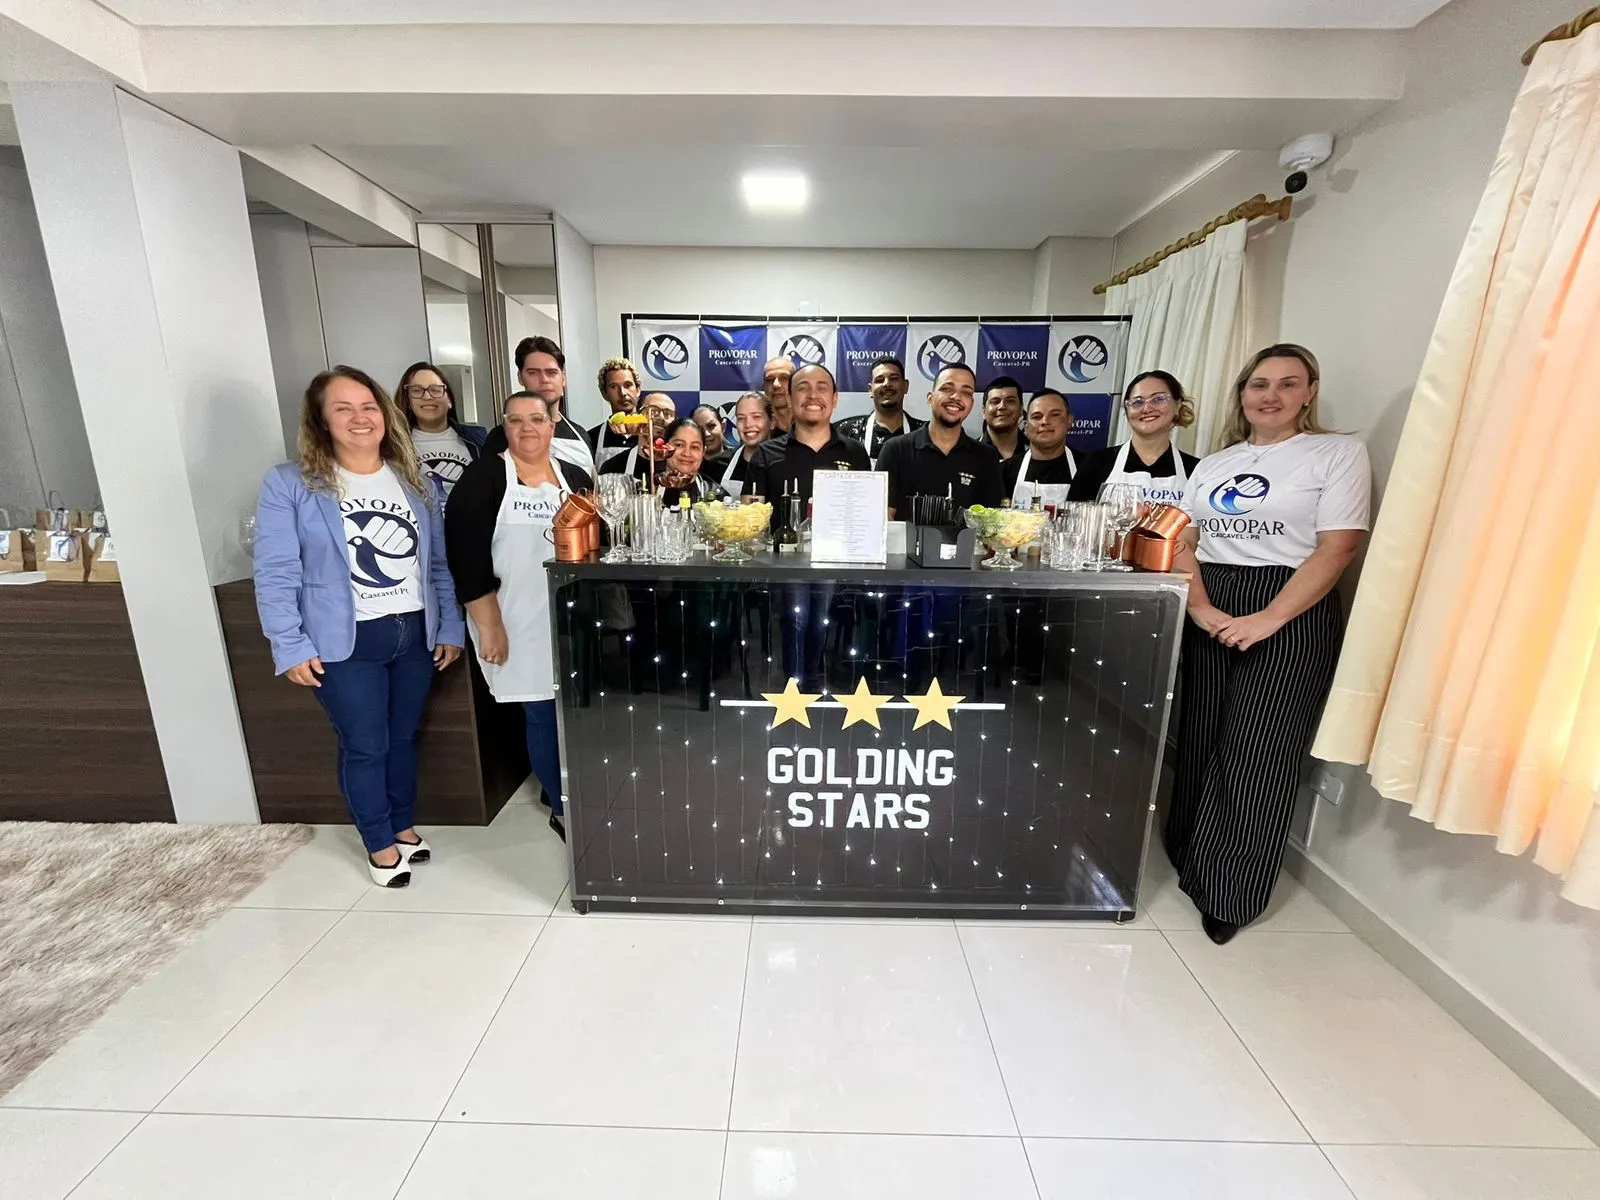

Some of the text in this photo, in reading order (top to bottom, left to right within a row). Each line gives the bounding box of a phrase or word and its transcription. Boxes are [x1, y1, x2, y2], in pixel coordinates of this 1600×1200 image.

[708, 349, 758, 359] PROVOPAR
[987, 350, 1038, 360] PROVOPAR
[1071, 419, 1101, 429] VOPAR
[416, 451, 468, 463] ROVOPAR
[1142, 488, 1184, 501] VOPAR
[513, 501, 560, 513] PROVO
[339, 498, 419, 530] OVOPA
[767, 747, 954, 787] GOLDING
[787, 792, 931, 830] STARS
